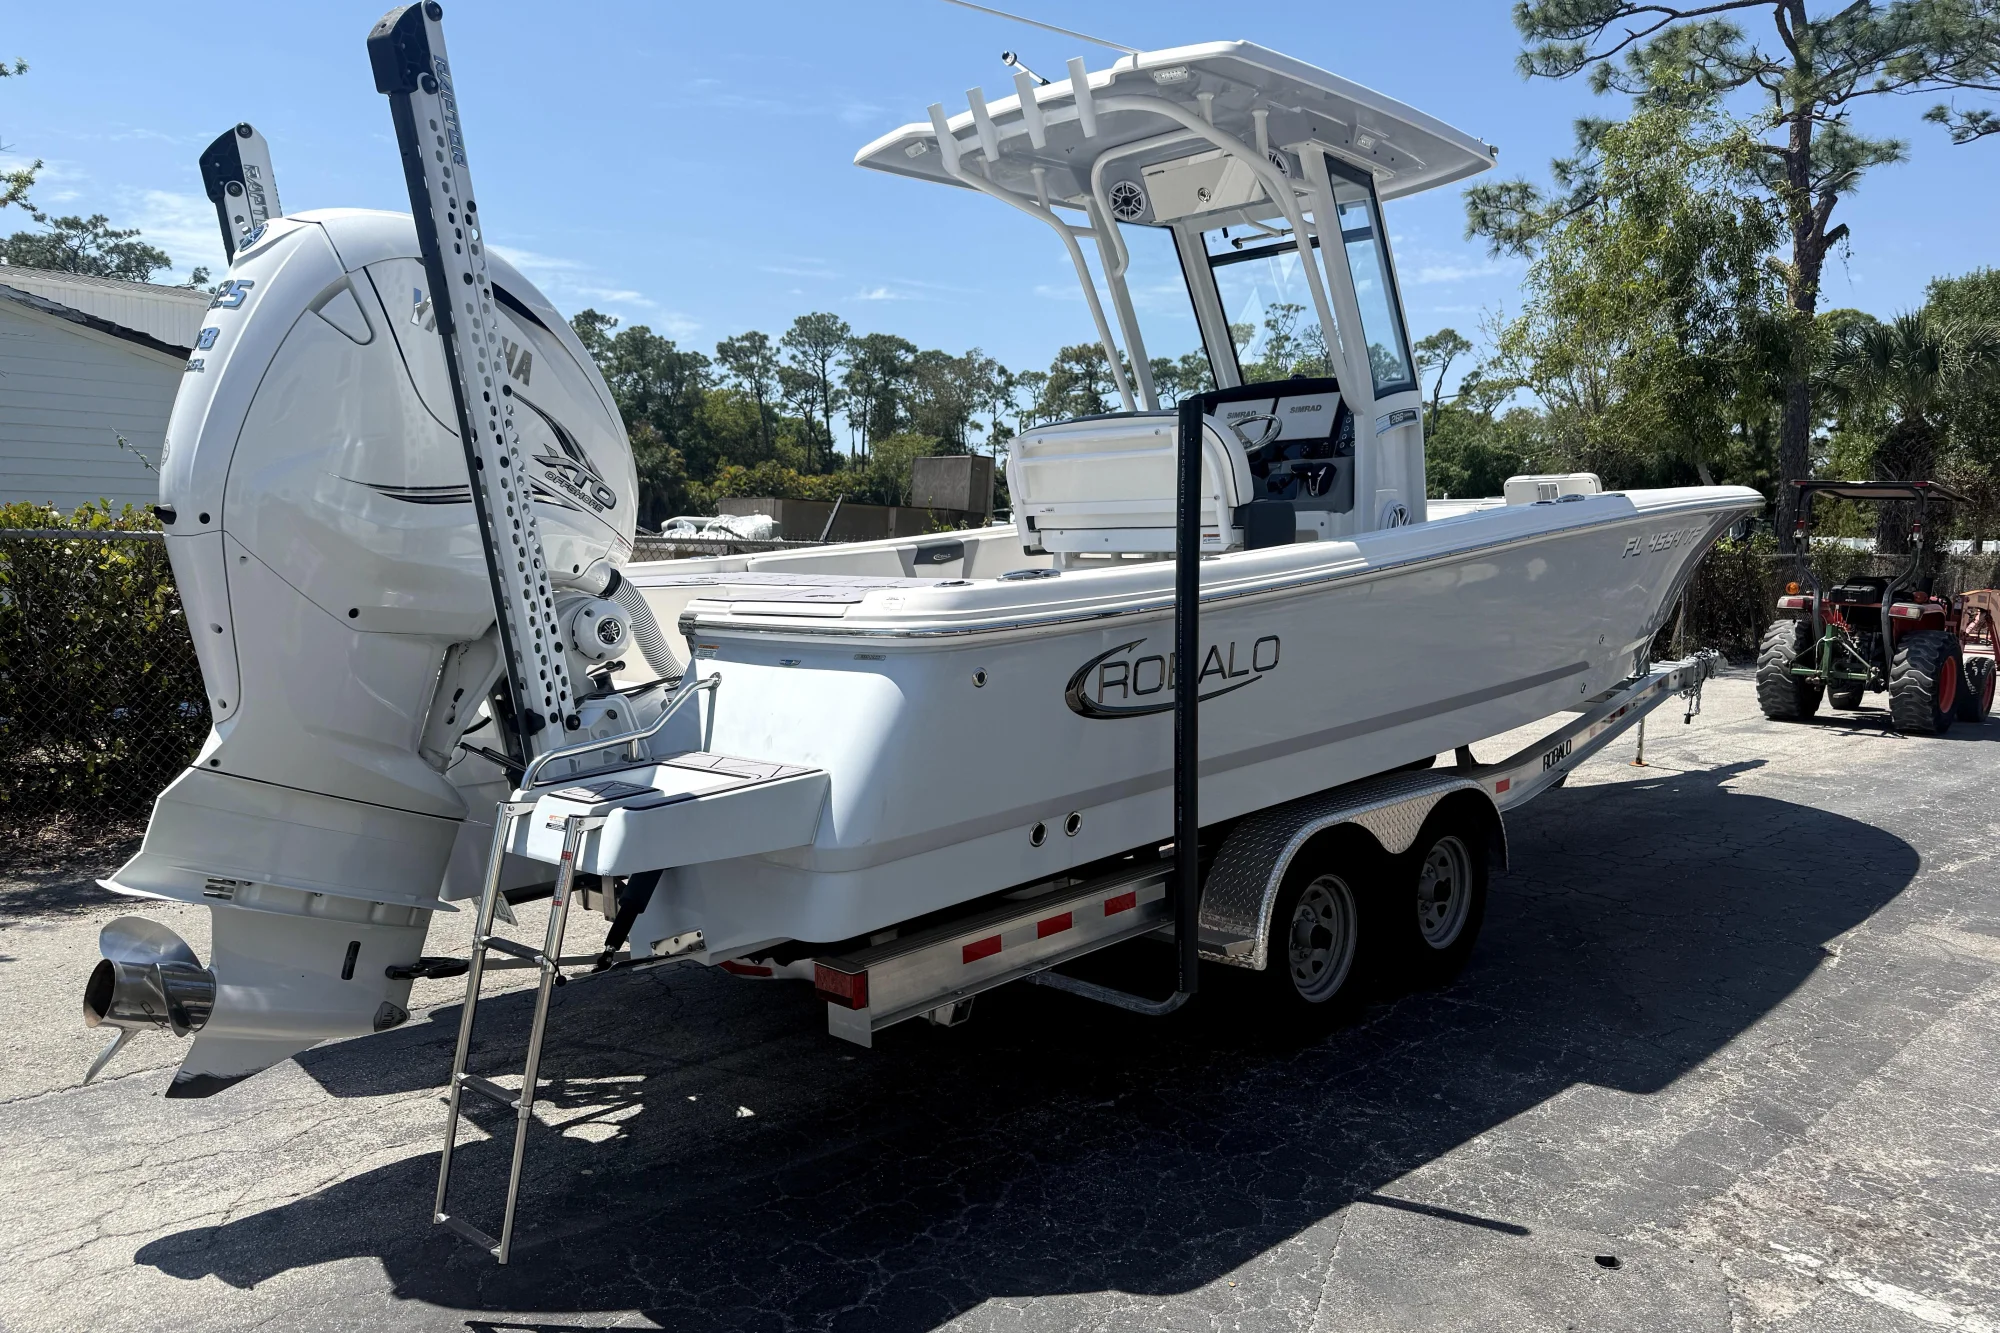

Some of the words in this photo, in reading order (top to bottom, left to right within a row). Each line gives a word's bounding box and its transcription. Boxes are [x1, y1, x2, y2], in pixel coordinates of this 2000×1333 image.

[433, 55, 467, 169] RAPTOR
[207, 279, 255, 311] 25
[1226, 410, 1257, 420] SIMRAD
[1289, 404, 1322, 414] SIMRAD
[1391, 412, 1404, 425] 266
[532, 443, 617, 510] XTO
[544, 470, 605, 514] OFFSHORE
[1622, 535, 1643, 559] FL
[1542, 738, 1572, 772] ROBALO
